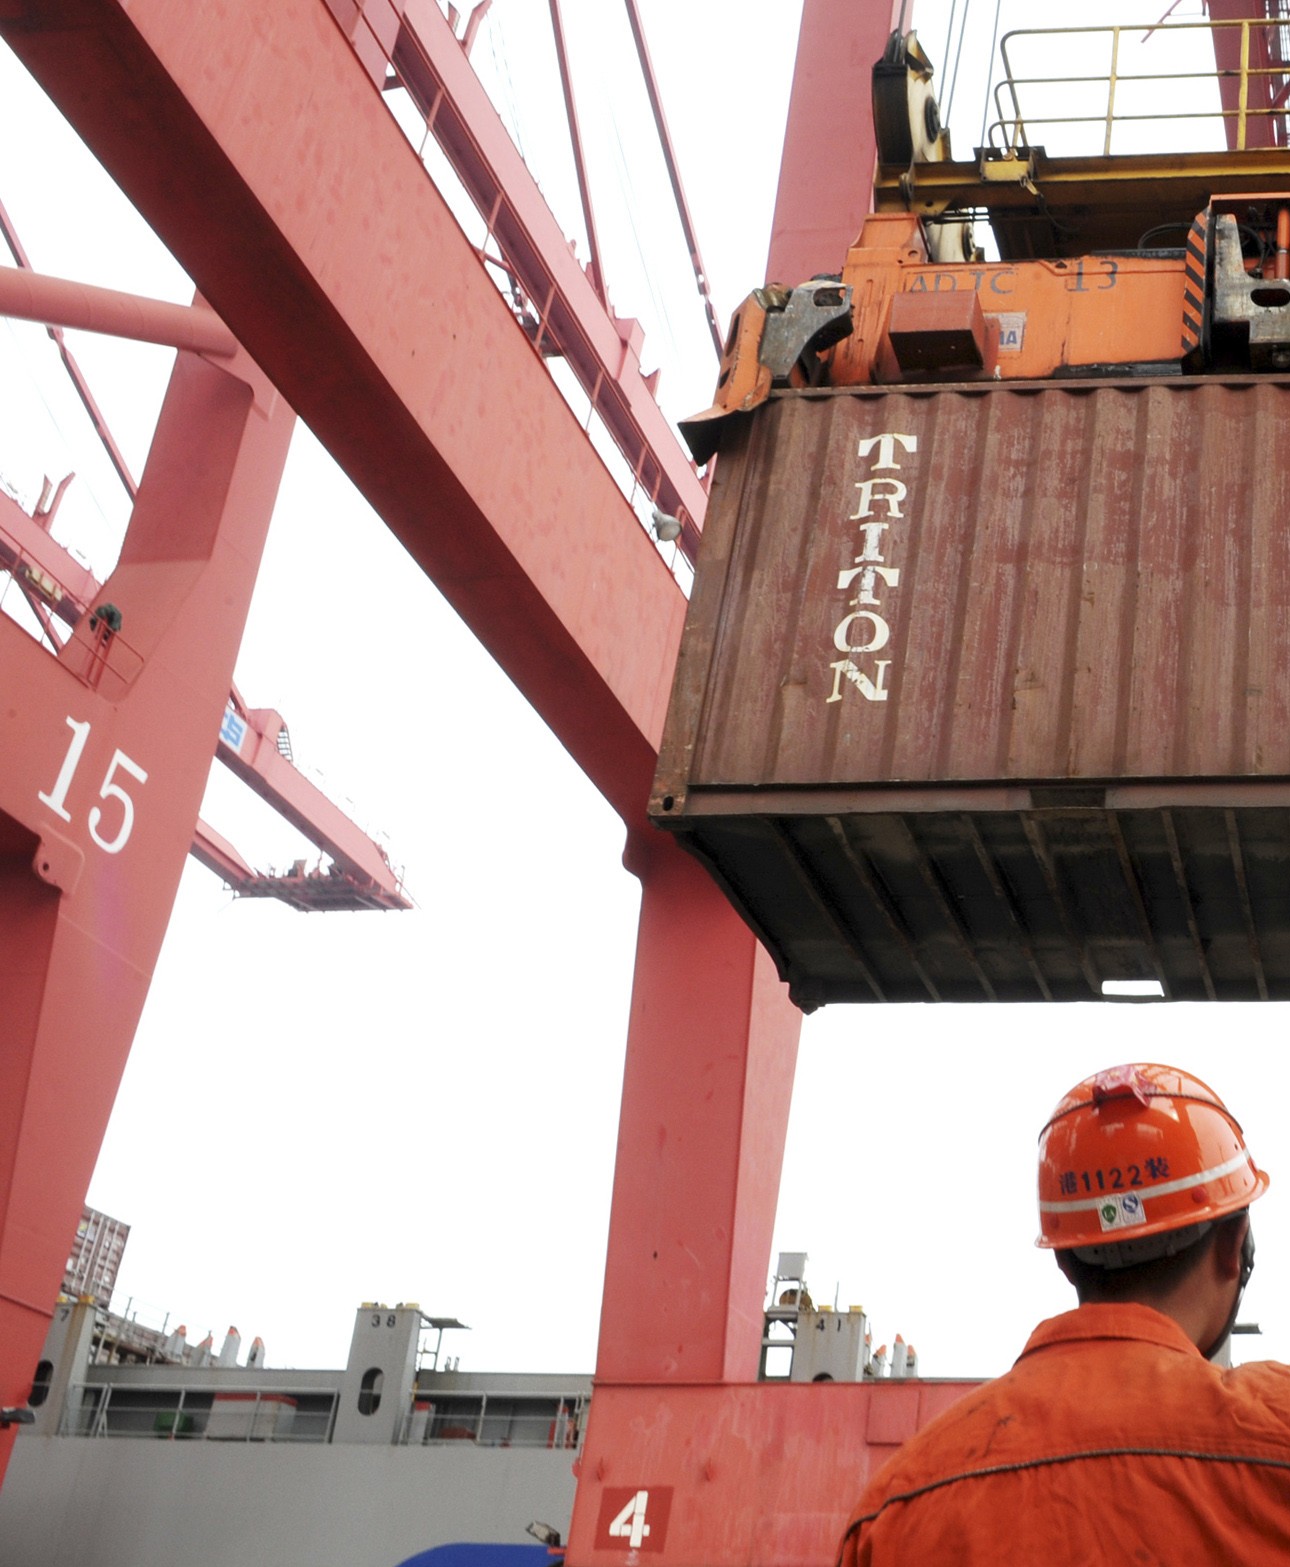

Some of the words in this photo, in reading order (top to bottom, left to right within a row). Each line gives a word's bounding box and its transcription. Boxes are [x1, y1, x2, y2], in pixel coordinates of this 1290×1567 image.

[1066, 260, 1119, 293] 13
[826, 433, 917, 703] TRITON
[38, 715, 149, 855] 15
[371, 1313, 396, 1329] 38
[816, 1318, 842, 1332] 41
[608, 1490, 651, 1548] 4
